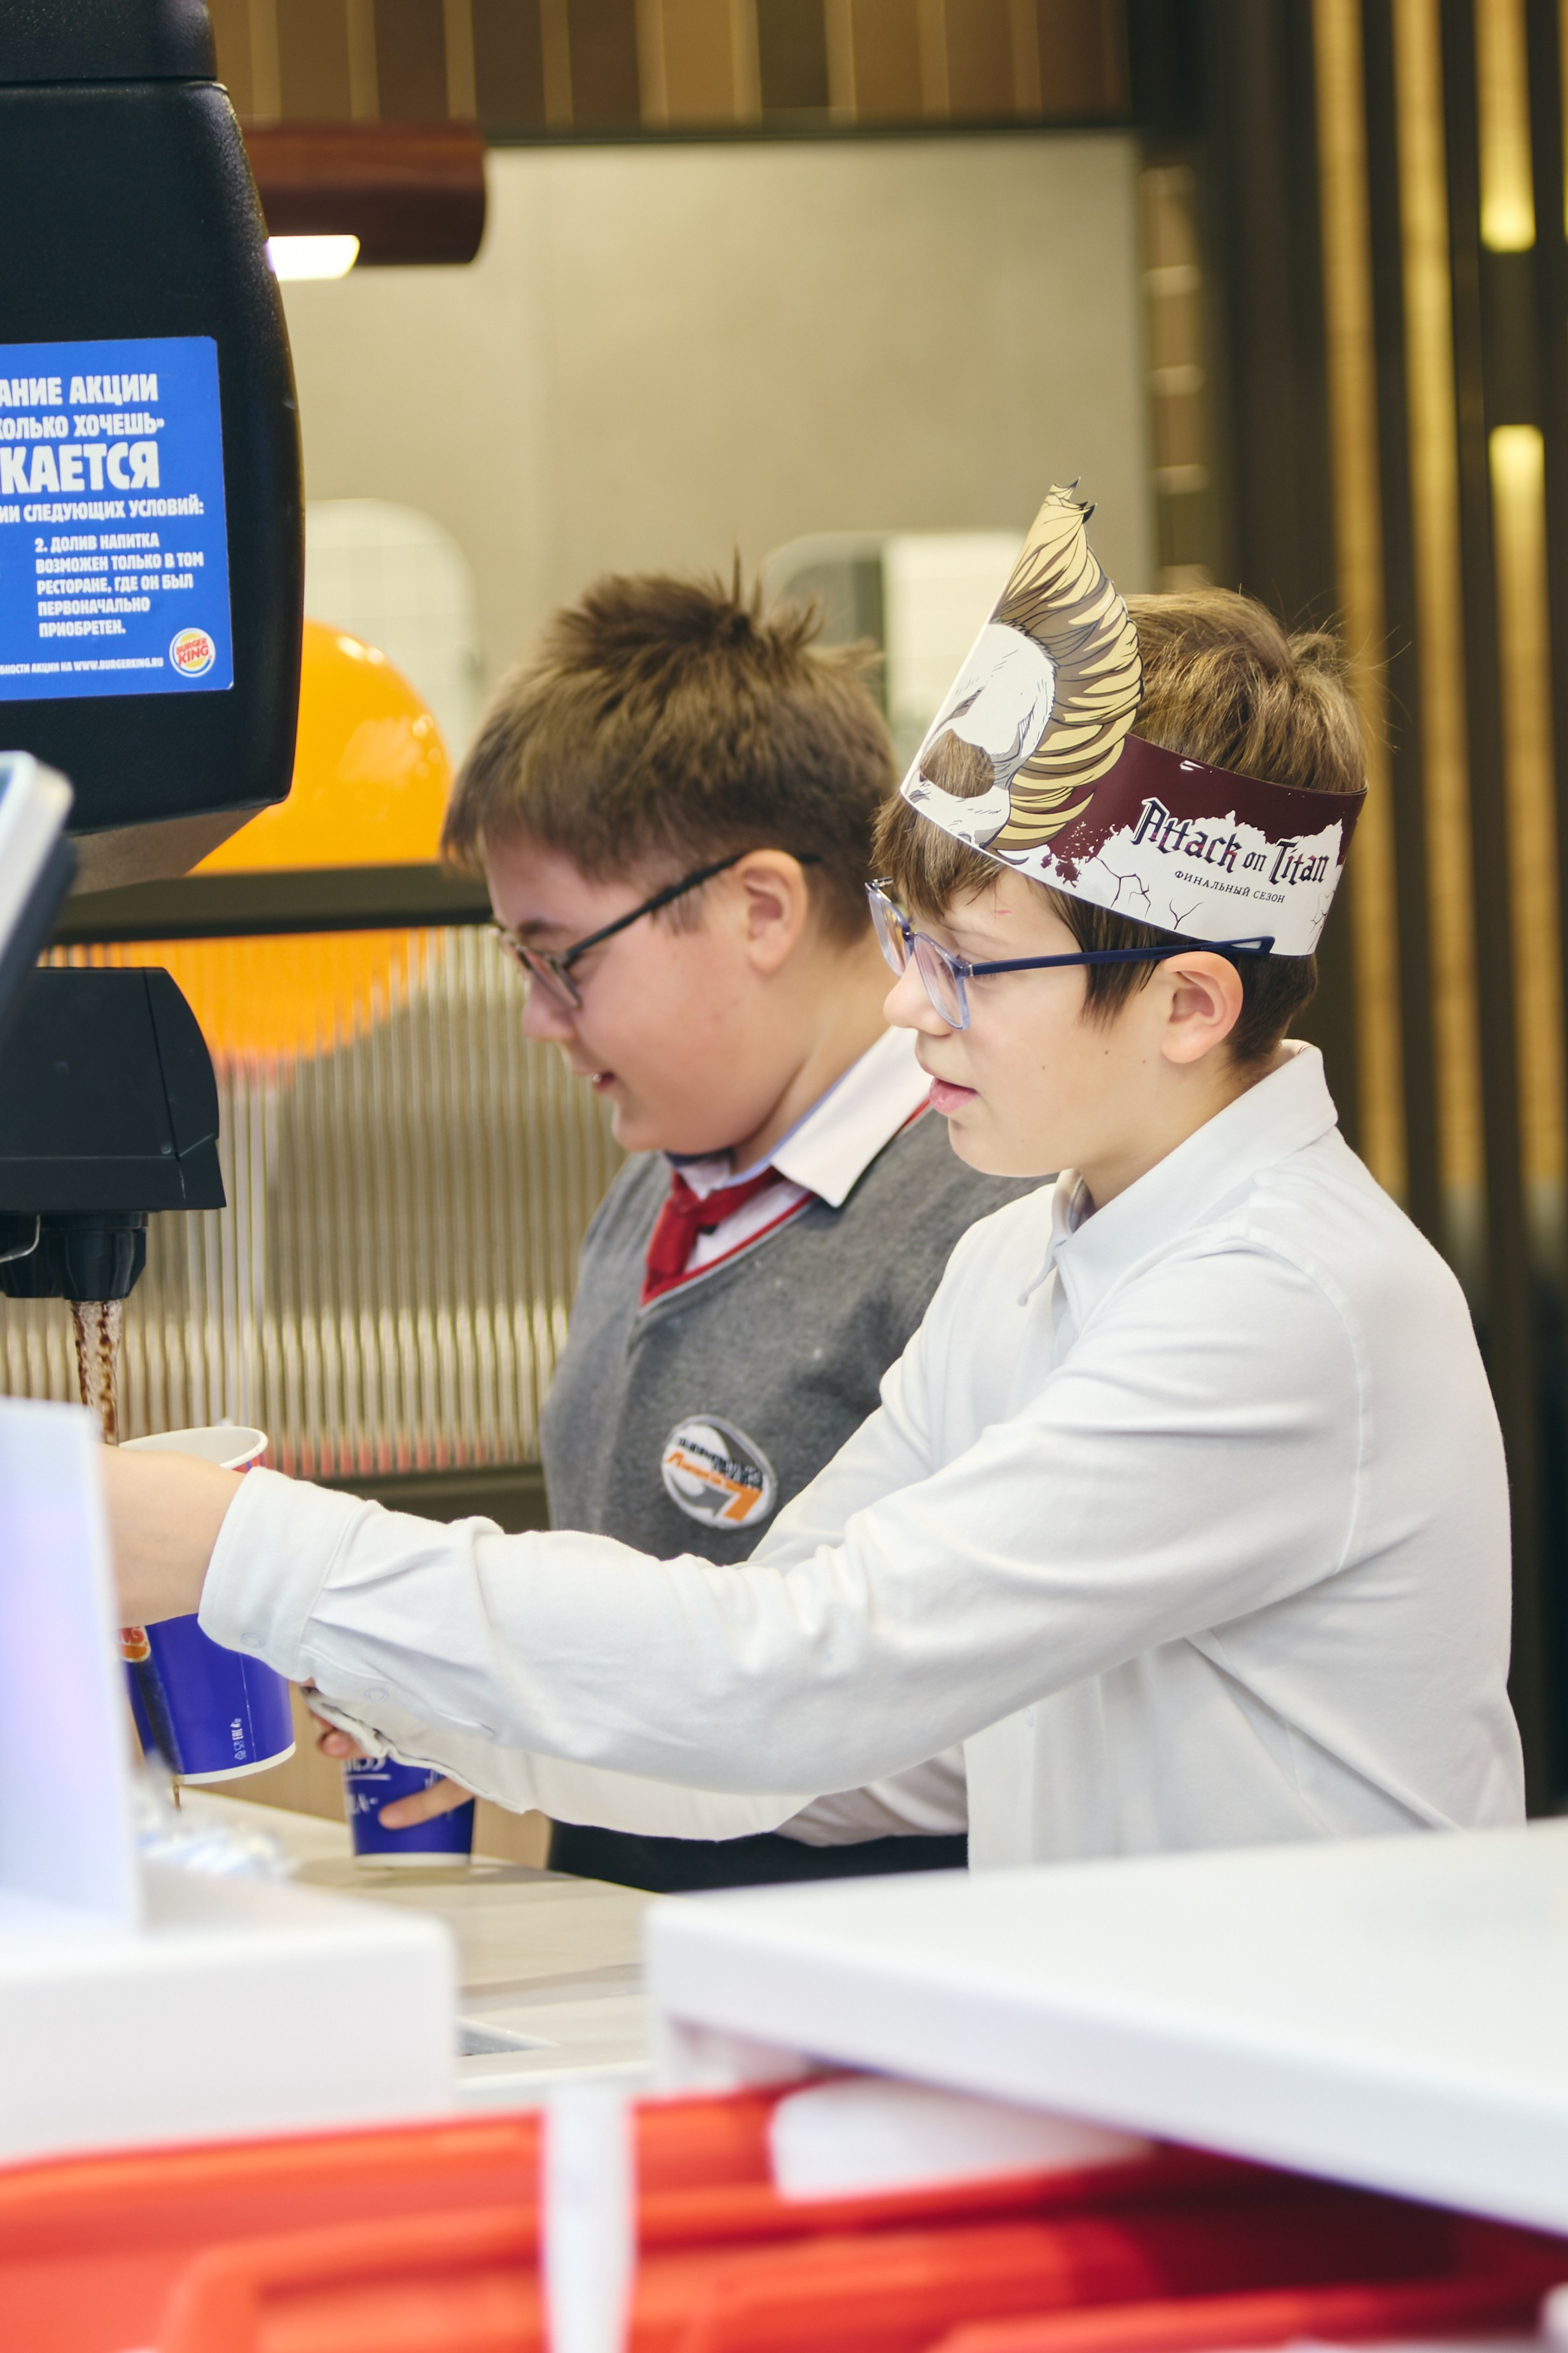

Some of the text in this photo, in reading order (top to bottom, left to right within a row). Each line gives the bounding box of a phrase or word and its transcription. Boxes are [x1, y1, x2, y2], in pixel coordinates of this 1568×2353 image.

[69, 374, 158, 405] АКЦИИ
[0, 415, 69, 440] ОЛЬКО
[24, 501, 125, 522] СЛЕДУЮЩИХ
[128, 494, 204, 518] УСЛОВИЙ:
[35, 533, 160, 553] 2. ДОЛИВ НАПИТКА
[36, 552, 204, 574] ВОЗМОЖЕН ТОЛЬКО В ТОМ
[37, 573, 193, 595] РЕСТОРАНЕ, ГДЕ ОН БЫЛ
[38, 597, 150, 616] ПЕРВОНАЧАЛЬНО
[39, 619, 126, 637] ПРИОБРЕТЕН.
[176, 638, 207, 655] BURGER
[178, 645, 209, 667] KING
[31, 662, 60, 673] АКЦИИ
[60, 662, 73, 671] НА
[1132, 797, 1329, 884] Attack on Titan
[1175, 870, 1286, 904] ФИНАЛЬНЫЙ СЕЗОН
